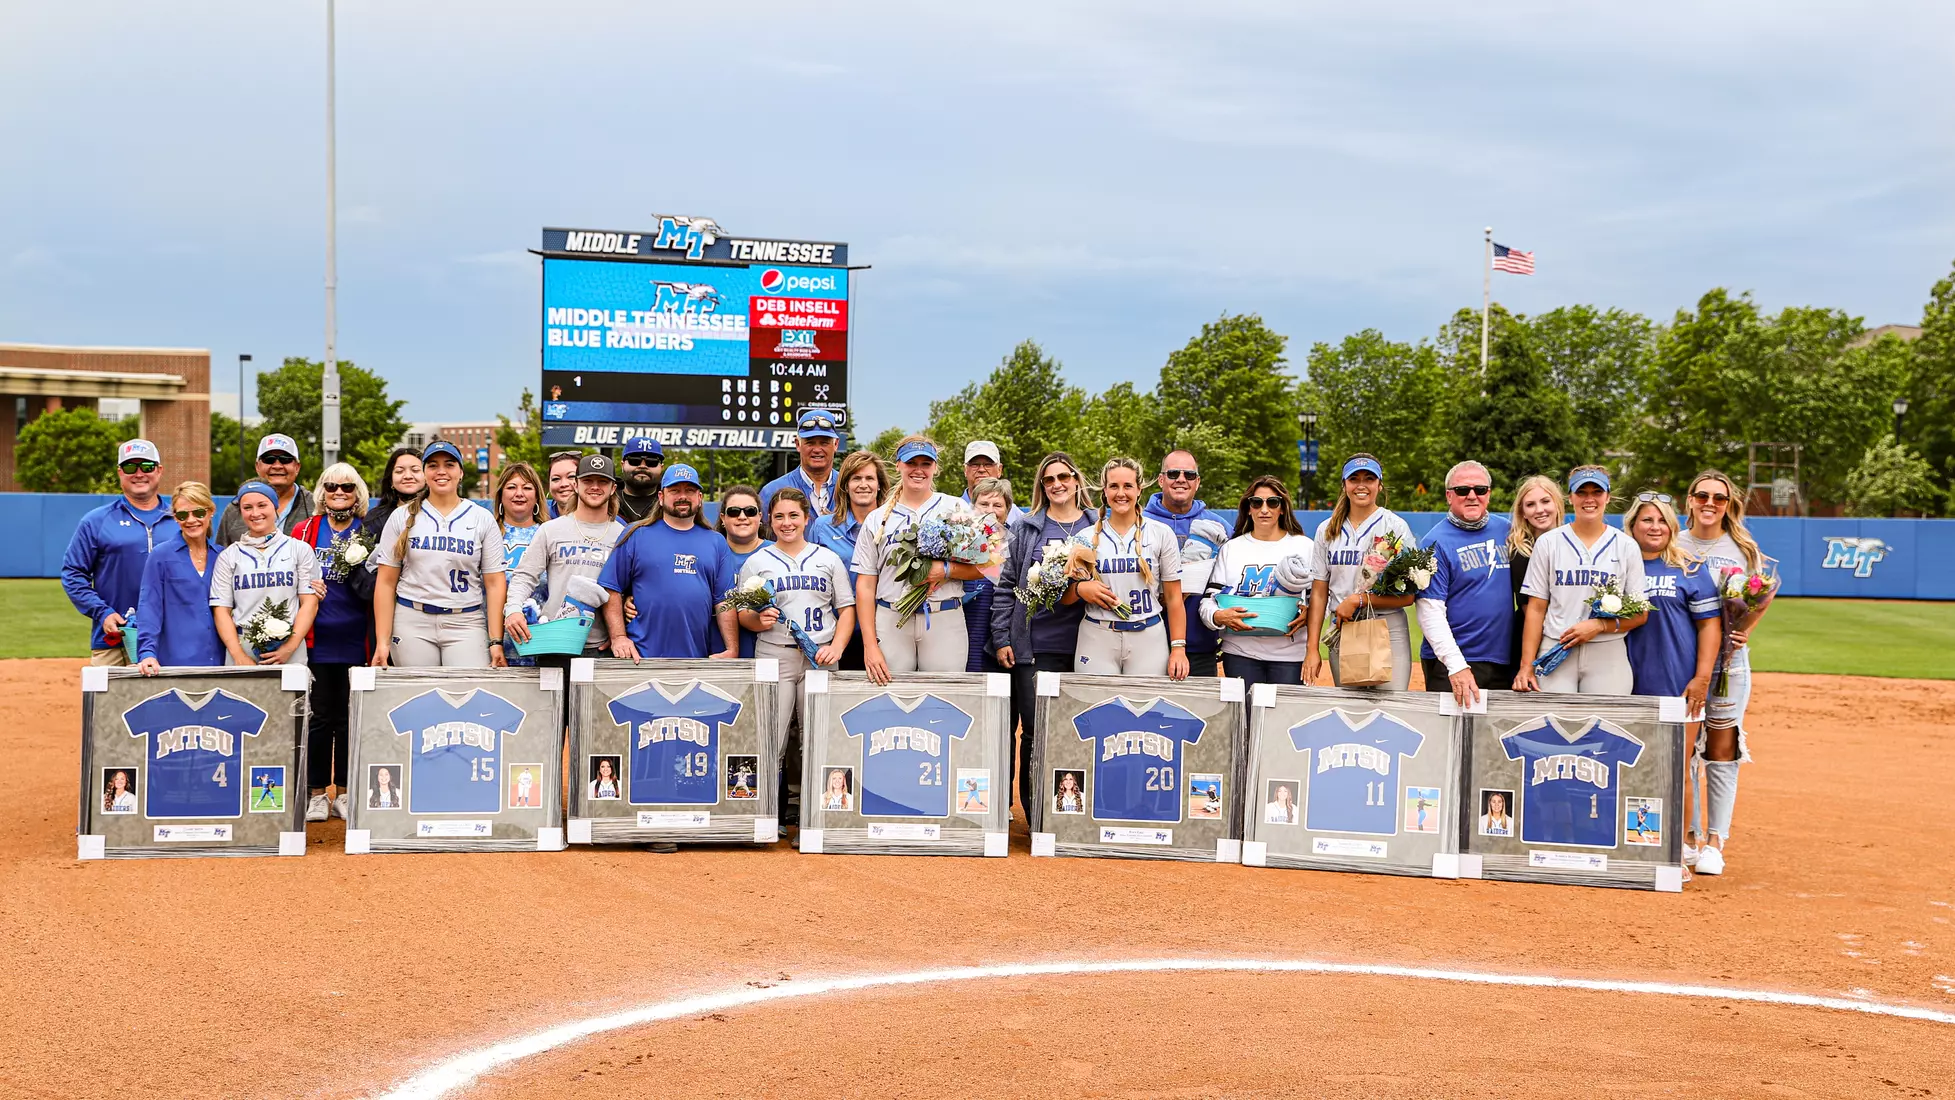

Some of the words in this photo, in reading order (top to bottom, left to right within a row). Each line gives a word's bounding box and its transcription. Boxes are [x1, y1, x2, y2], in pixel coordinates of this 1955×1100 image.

[565, 231, 641, 254] MIDDLE
[730, 240, 836, 263] TENNESSEE
[787, 276, 836, 292] pepsi
[756, 299, 786, 312] DEB
[790, 300, 839, 314] INSELL
[547, 307, 627, 328] MIDDLE
[631, 310, 746, 333] TENNESSEE
[547, 328, 601, 348] BLUE
[606, 331, 694, 350] RAIDERS
[574, 375, 581, 386] 1
[769, 363, 803, 376] 10:44
[806, 364, 826, 377] AM
[722, 380, 731, 392] R
[737, 380, 746, 392] H
[752, 380, 760, 393] E
[770, 380, 779, 393] B
[784, 381, 792, 393] 0
[722, 394, 731, 405] 0
[738, 395, 746, 406] 0
[752, 395, 760, 406] 0
[771, 395, 779, 408] S
[784, 397, 792, 407] 0
[722, 409, 731, 420] 0
[738, 410, 746, 421] 0
[752, 410, 760, 421] 0
[784, 412, 792, 422] 0
[574, 426, 620, 444] BLUE
[686, 429, 767, 447] SOFTBALL
[770, 433, 798, 448] FIE
[409, 536, 474, 556] RAIDERS
[1821, 538, 1884, 578] MT
[581, 560, 605, 568] RAIDER
[234, 571, 294, 591] RAIDERS
[449, 569, 470, 593] 15
[1129, 589, 1152, 615] 20
[804, 607, 823, 631] 19
[156, 725, 234, 759] MTSU
[421, 721, 496, 754] MTSU
[637, 717, 710, 750] MTSU
[868, 726, 942, 757] MTSU
[1102, 730, 1173, 762] MTSU
[470, 757, 494, 782] 15
[684, 752, 708, 777] 19
[1316, 743, 1390, 776] MTSU
[1531, 754, 1609, 789] MTSU
[212, 763, 228, 788] 4
[919, 762, 942, 786] 21
[1145, 766, 1174, 791] 20
[1366, 780, 1385, 806] 11
[1589, 793, 1599, 819] 1
